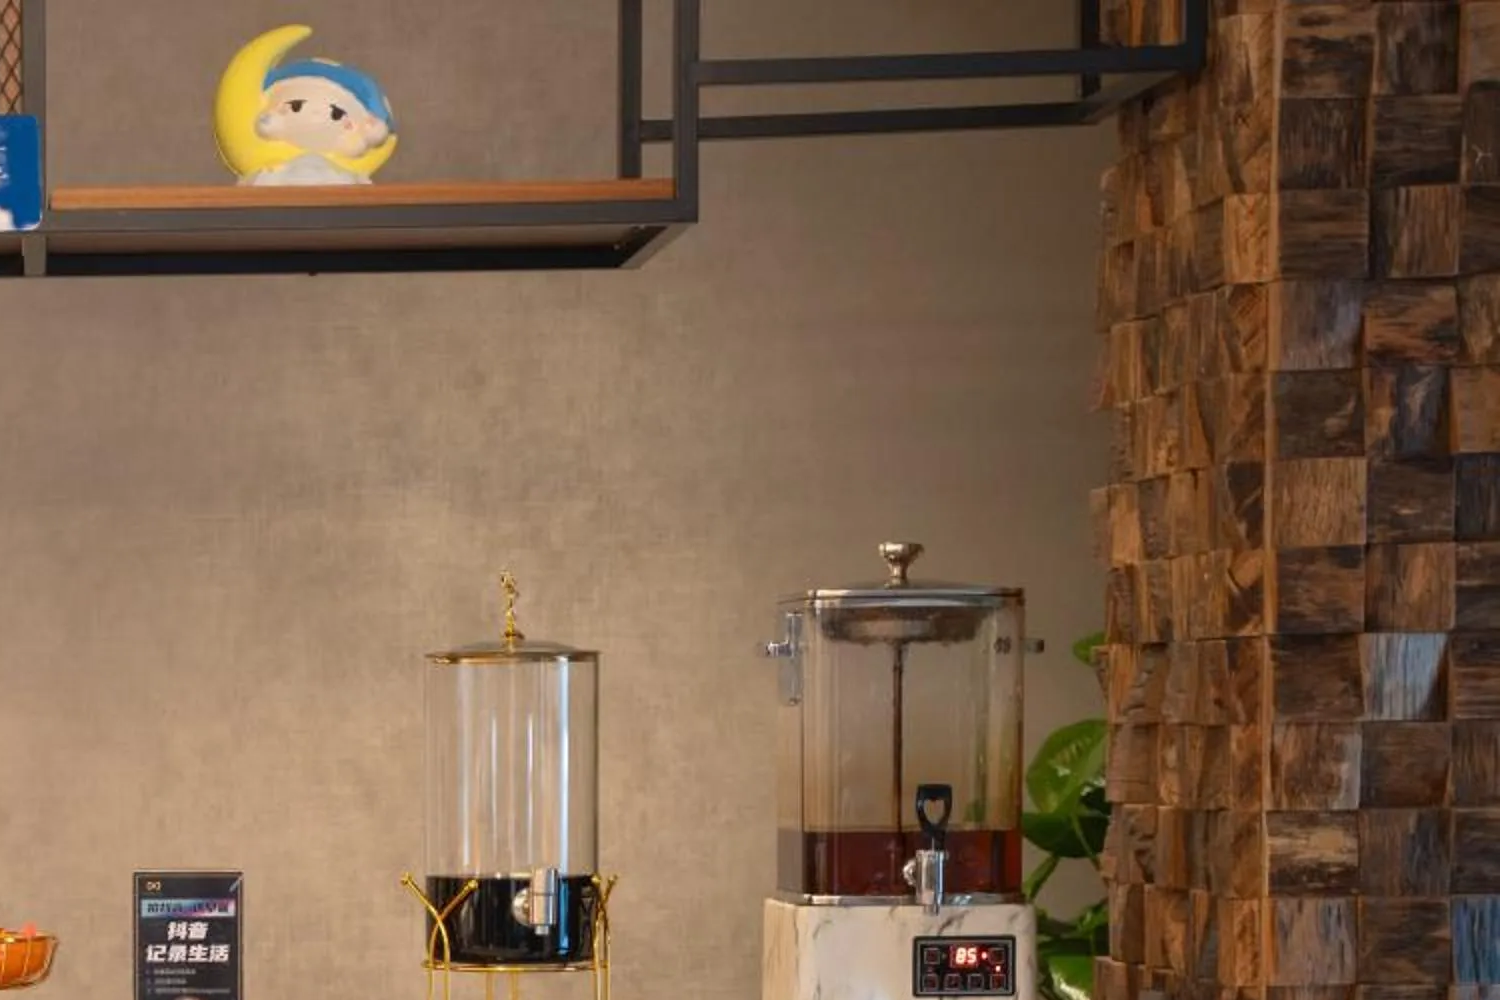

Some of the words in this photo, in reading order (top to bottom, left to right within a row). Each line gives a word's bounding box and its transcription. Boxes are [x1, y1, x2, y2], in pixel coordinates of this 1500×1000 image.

[167, 921, 209, 941] 抖音
[146, 944, 230, 963] 记录生活
